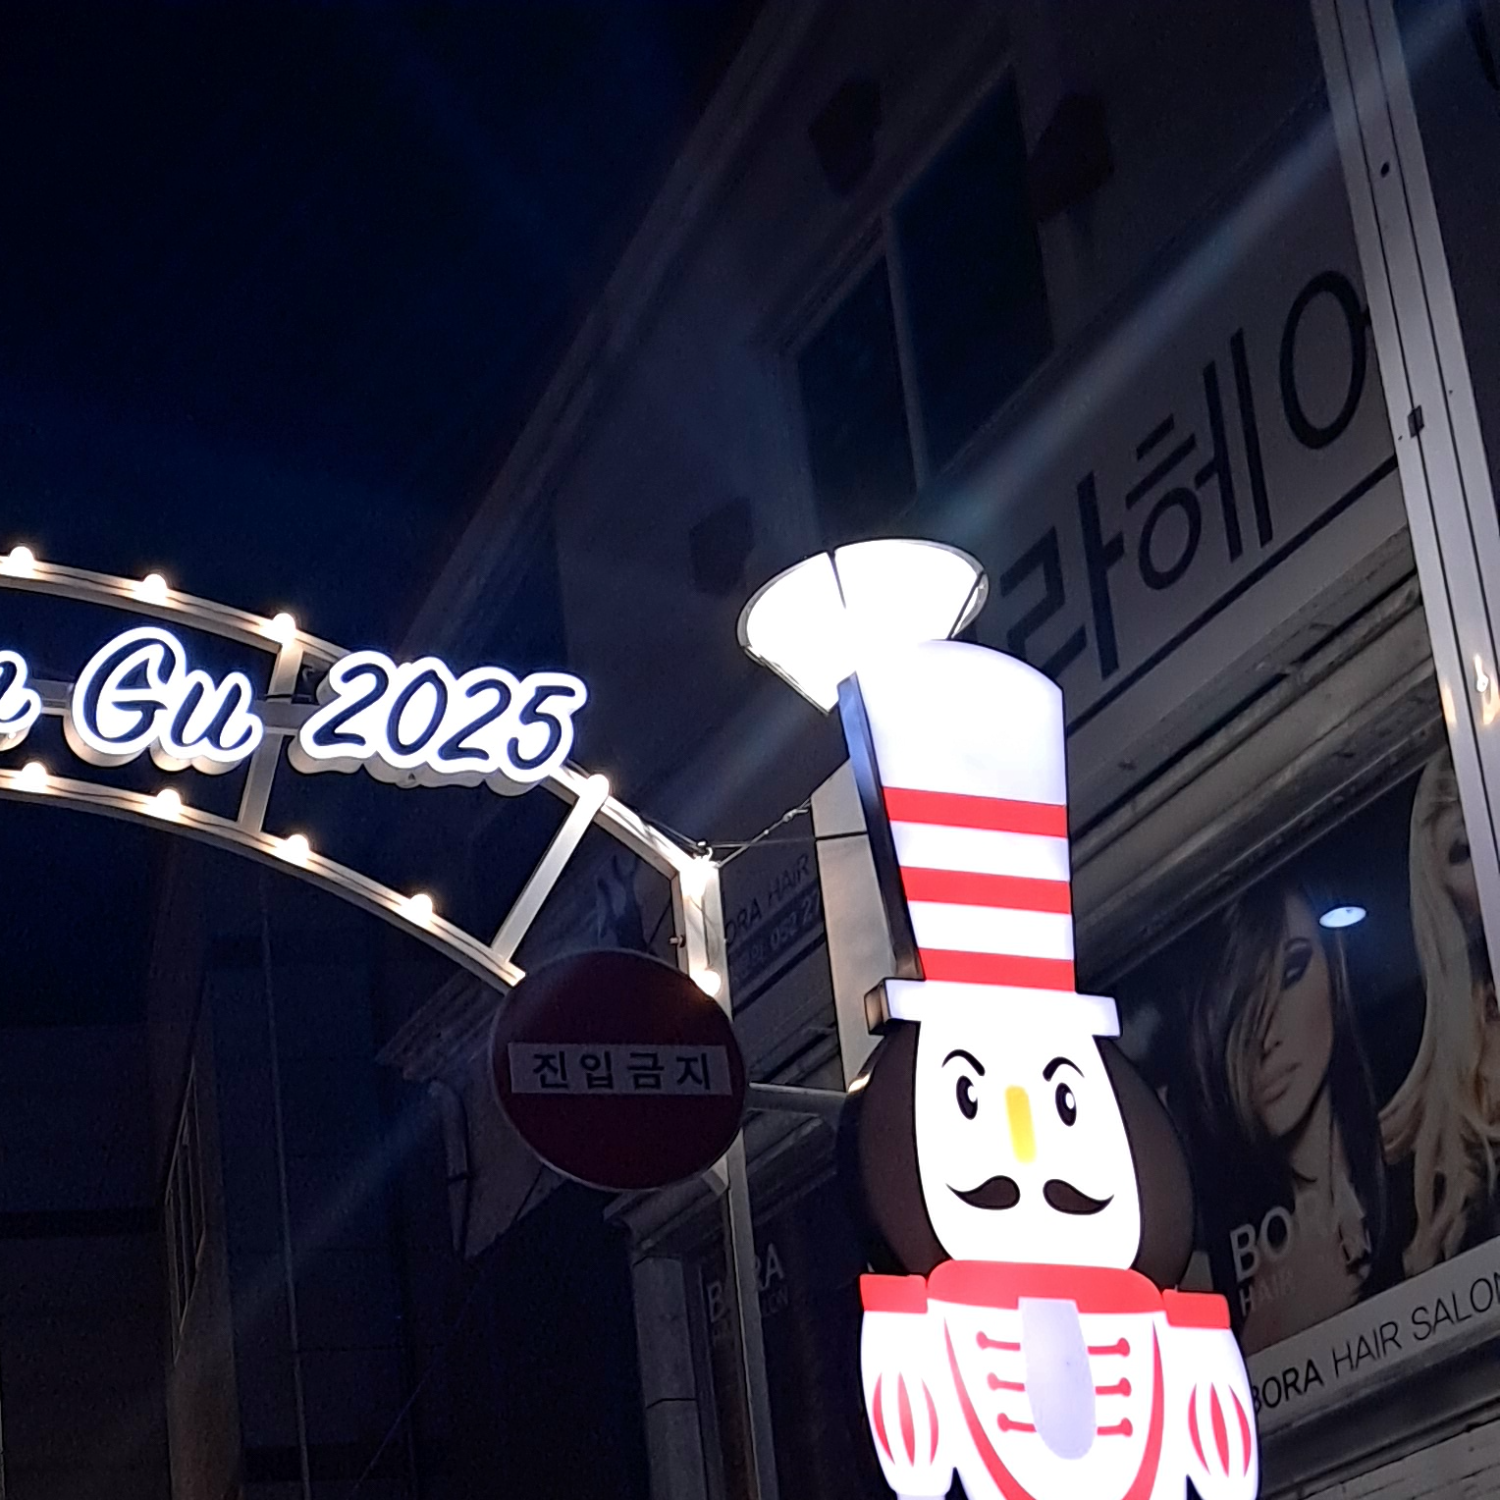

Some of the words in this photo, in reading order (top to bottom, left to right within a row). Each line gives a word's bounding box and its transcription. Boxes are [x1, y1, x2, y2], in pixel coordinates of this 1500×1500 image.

[1000, 270, 1373, 680] 라헤
[63, 626, 262, 772] Gu
[291, 651, 588, 795] 2025
[725, 898, 762, 947] ORA
[533, 1050, 712, 1090] 진입금지
[1332, 1321, 1403, 1378] HAIR
